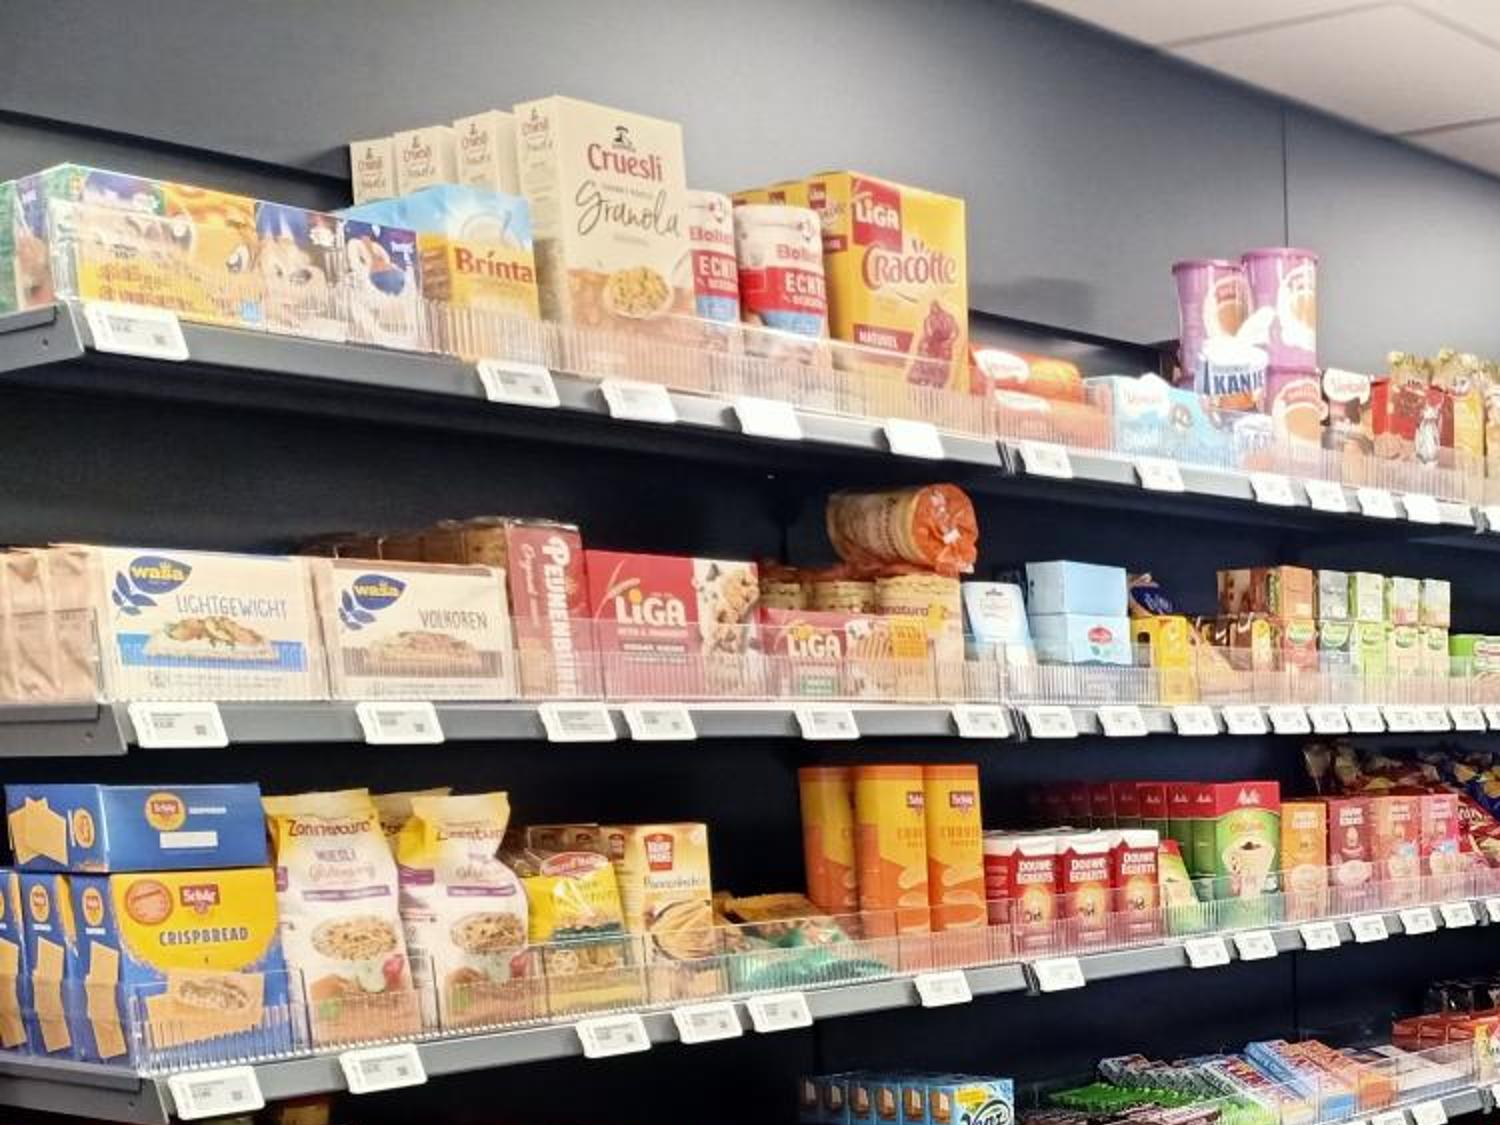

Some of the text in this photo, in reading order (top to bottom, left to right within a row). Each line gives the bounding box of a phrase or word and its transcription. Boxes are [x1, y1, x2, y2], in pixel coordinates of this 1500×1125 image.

[587, 143, 663, 182] Cruesli
[575, 179, 681, 237] Granola
[455, 247, 533, 286] Brinta
[177, 594, 287, 619] LICHTGEWICHT
[159, 927, 249, 945] CRISPBREAD
